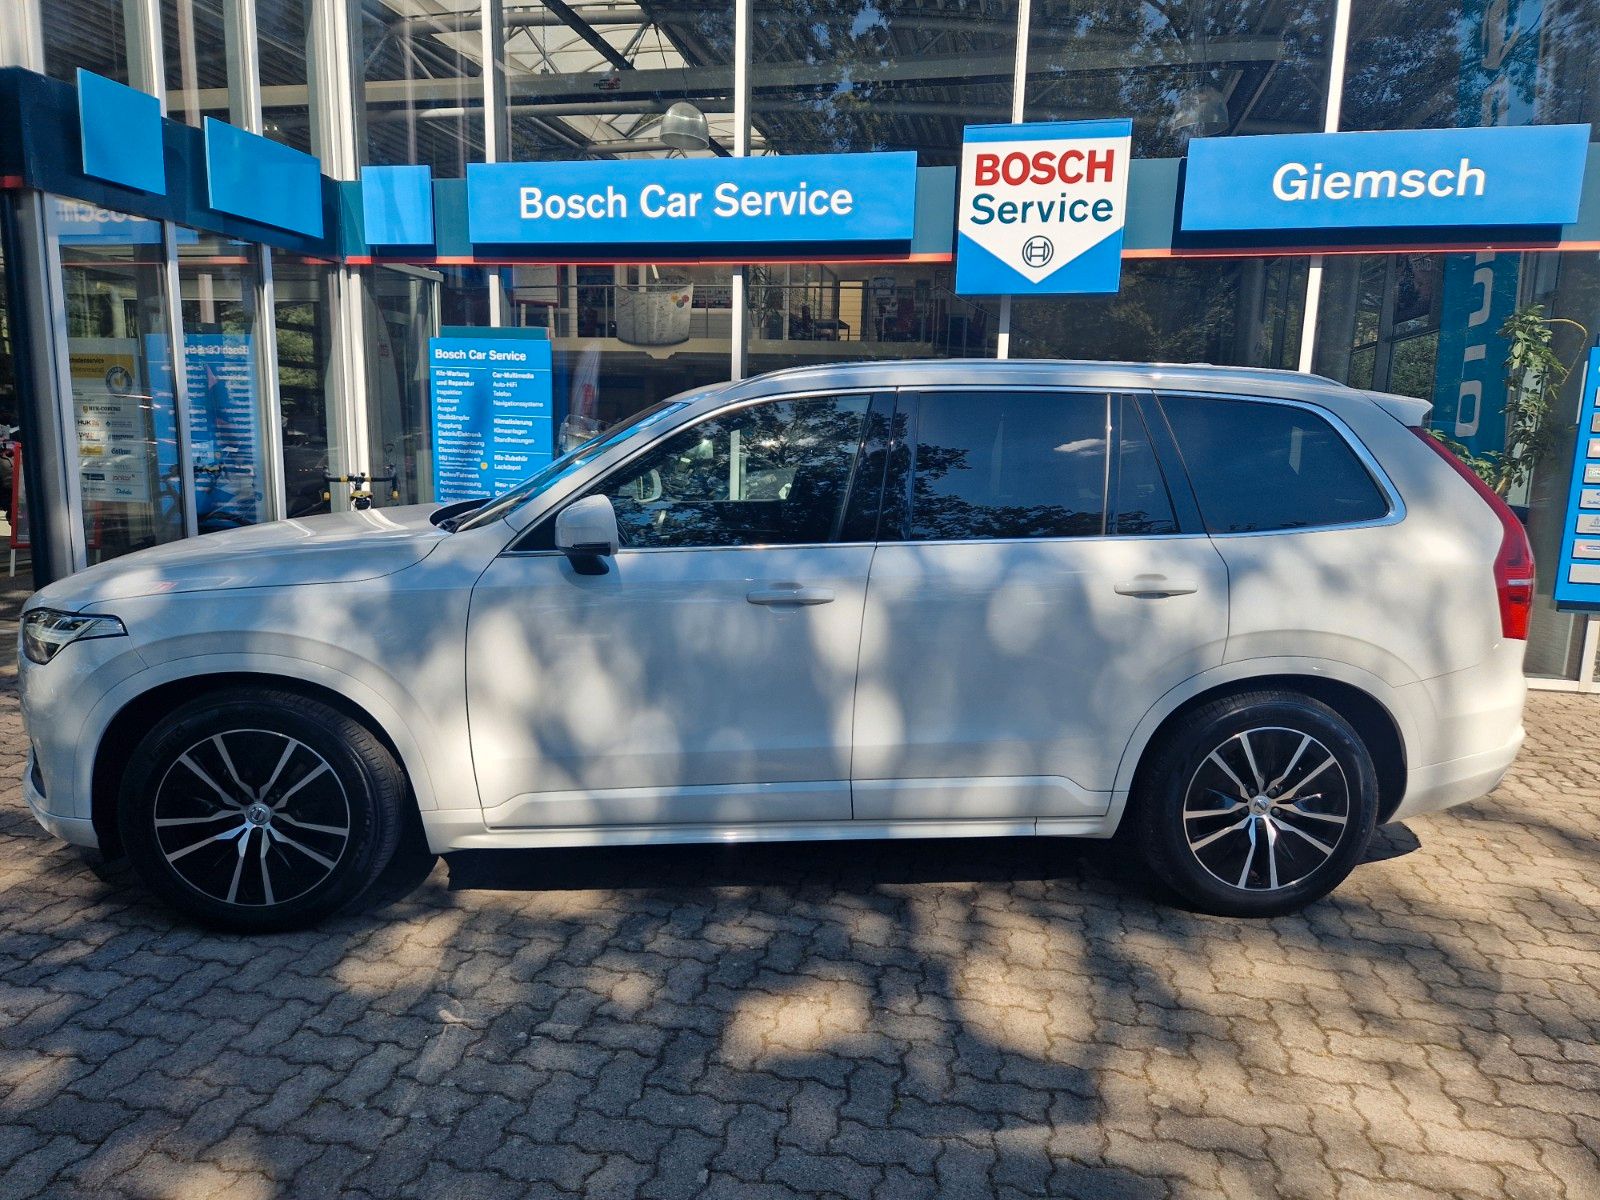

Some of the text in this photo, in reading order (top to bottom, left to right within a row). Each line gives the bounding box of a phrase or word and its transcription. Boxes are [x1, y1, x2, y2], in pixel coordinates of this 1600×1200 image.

[975, 149, 1115, 186] BOSCH
[1272, 157, 1485, 202] Giemsch
[519, 182, 854, 219] Bosch Car Service
[970, 192, 1114, 225] Service
[435, 349, 527, 361] Bosch Car Service
[492, 371, 535, 379] Car-Multimedia
